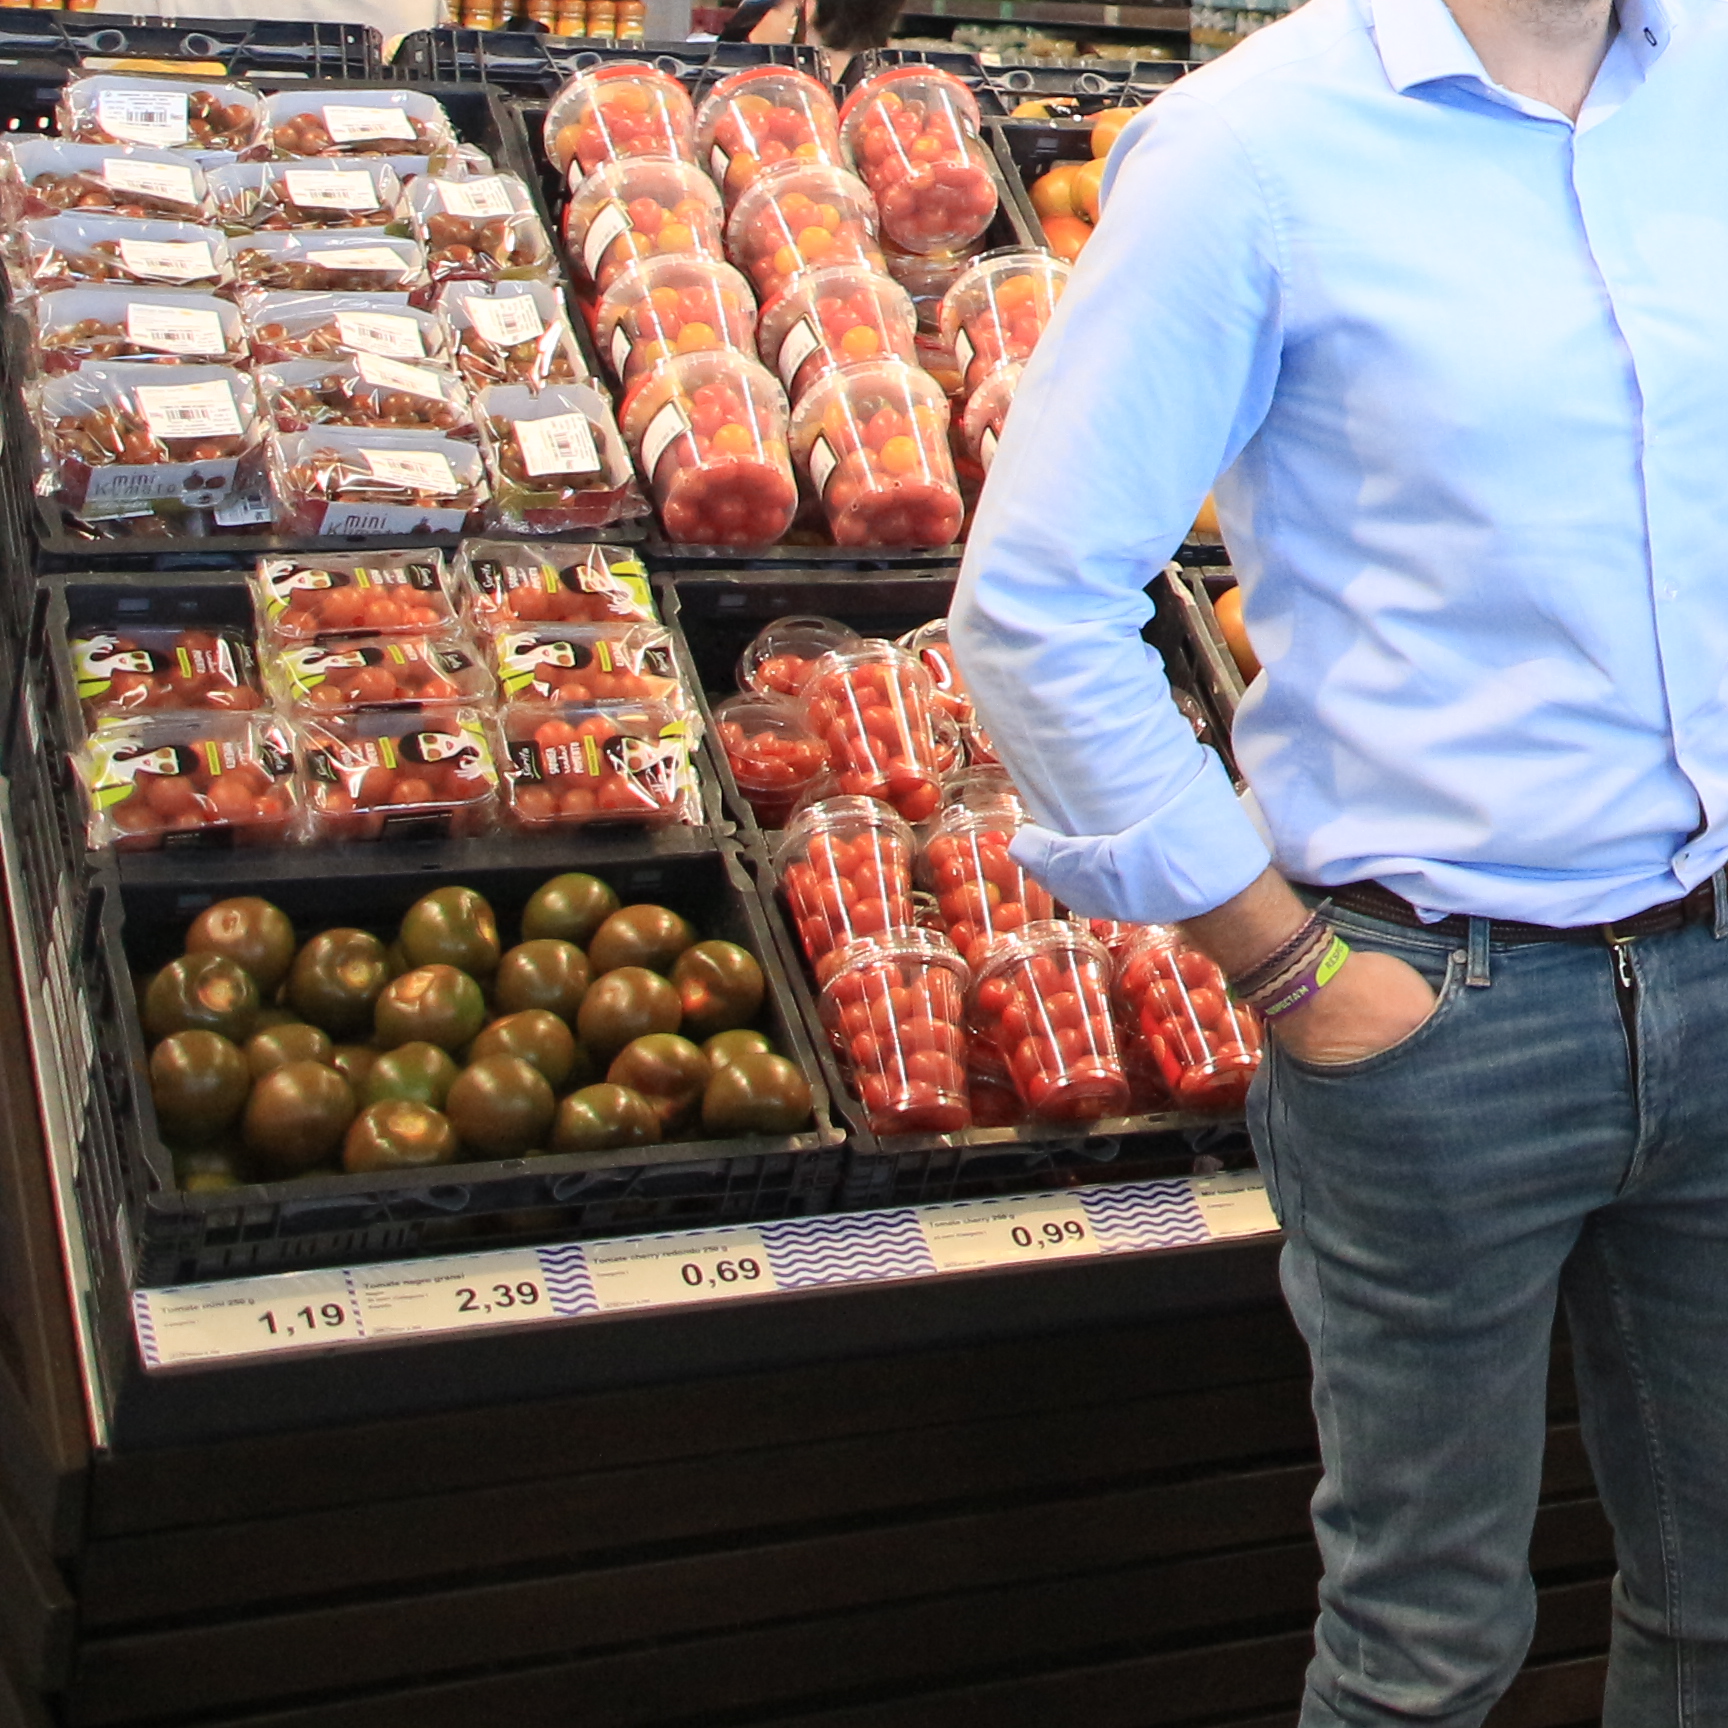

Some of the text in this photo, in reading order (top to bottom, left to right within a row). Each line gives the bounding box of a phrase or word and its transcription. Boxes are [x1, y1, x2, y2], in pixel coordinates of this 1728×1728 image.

[113, 470, 157, 486] mini
[346, 512, 389, 530] mini
[929, 1219, 961, 1229] Tomate
[1010, 1220, 1086, 1250] 0,99
[594, 1255, 628, 1265] Tomate
[630, 1251, 660, 1261] cherry
[680, 1257, 762, 1289] 0,69
[363, 1281, 400, 1290] Tomate
[455, 1281, 540, 1314] 2,39
[161, 1303, 200, 1314] Tomate
[258, 1303, 346, 1337] 1,19
